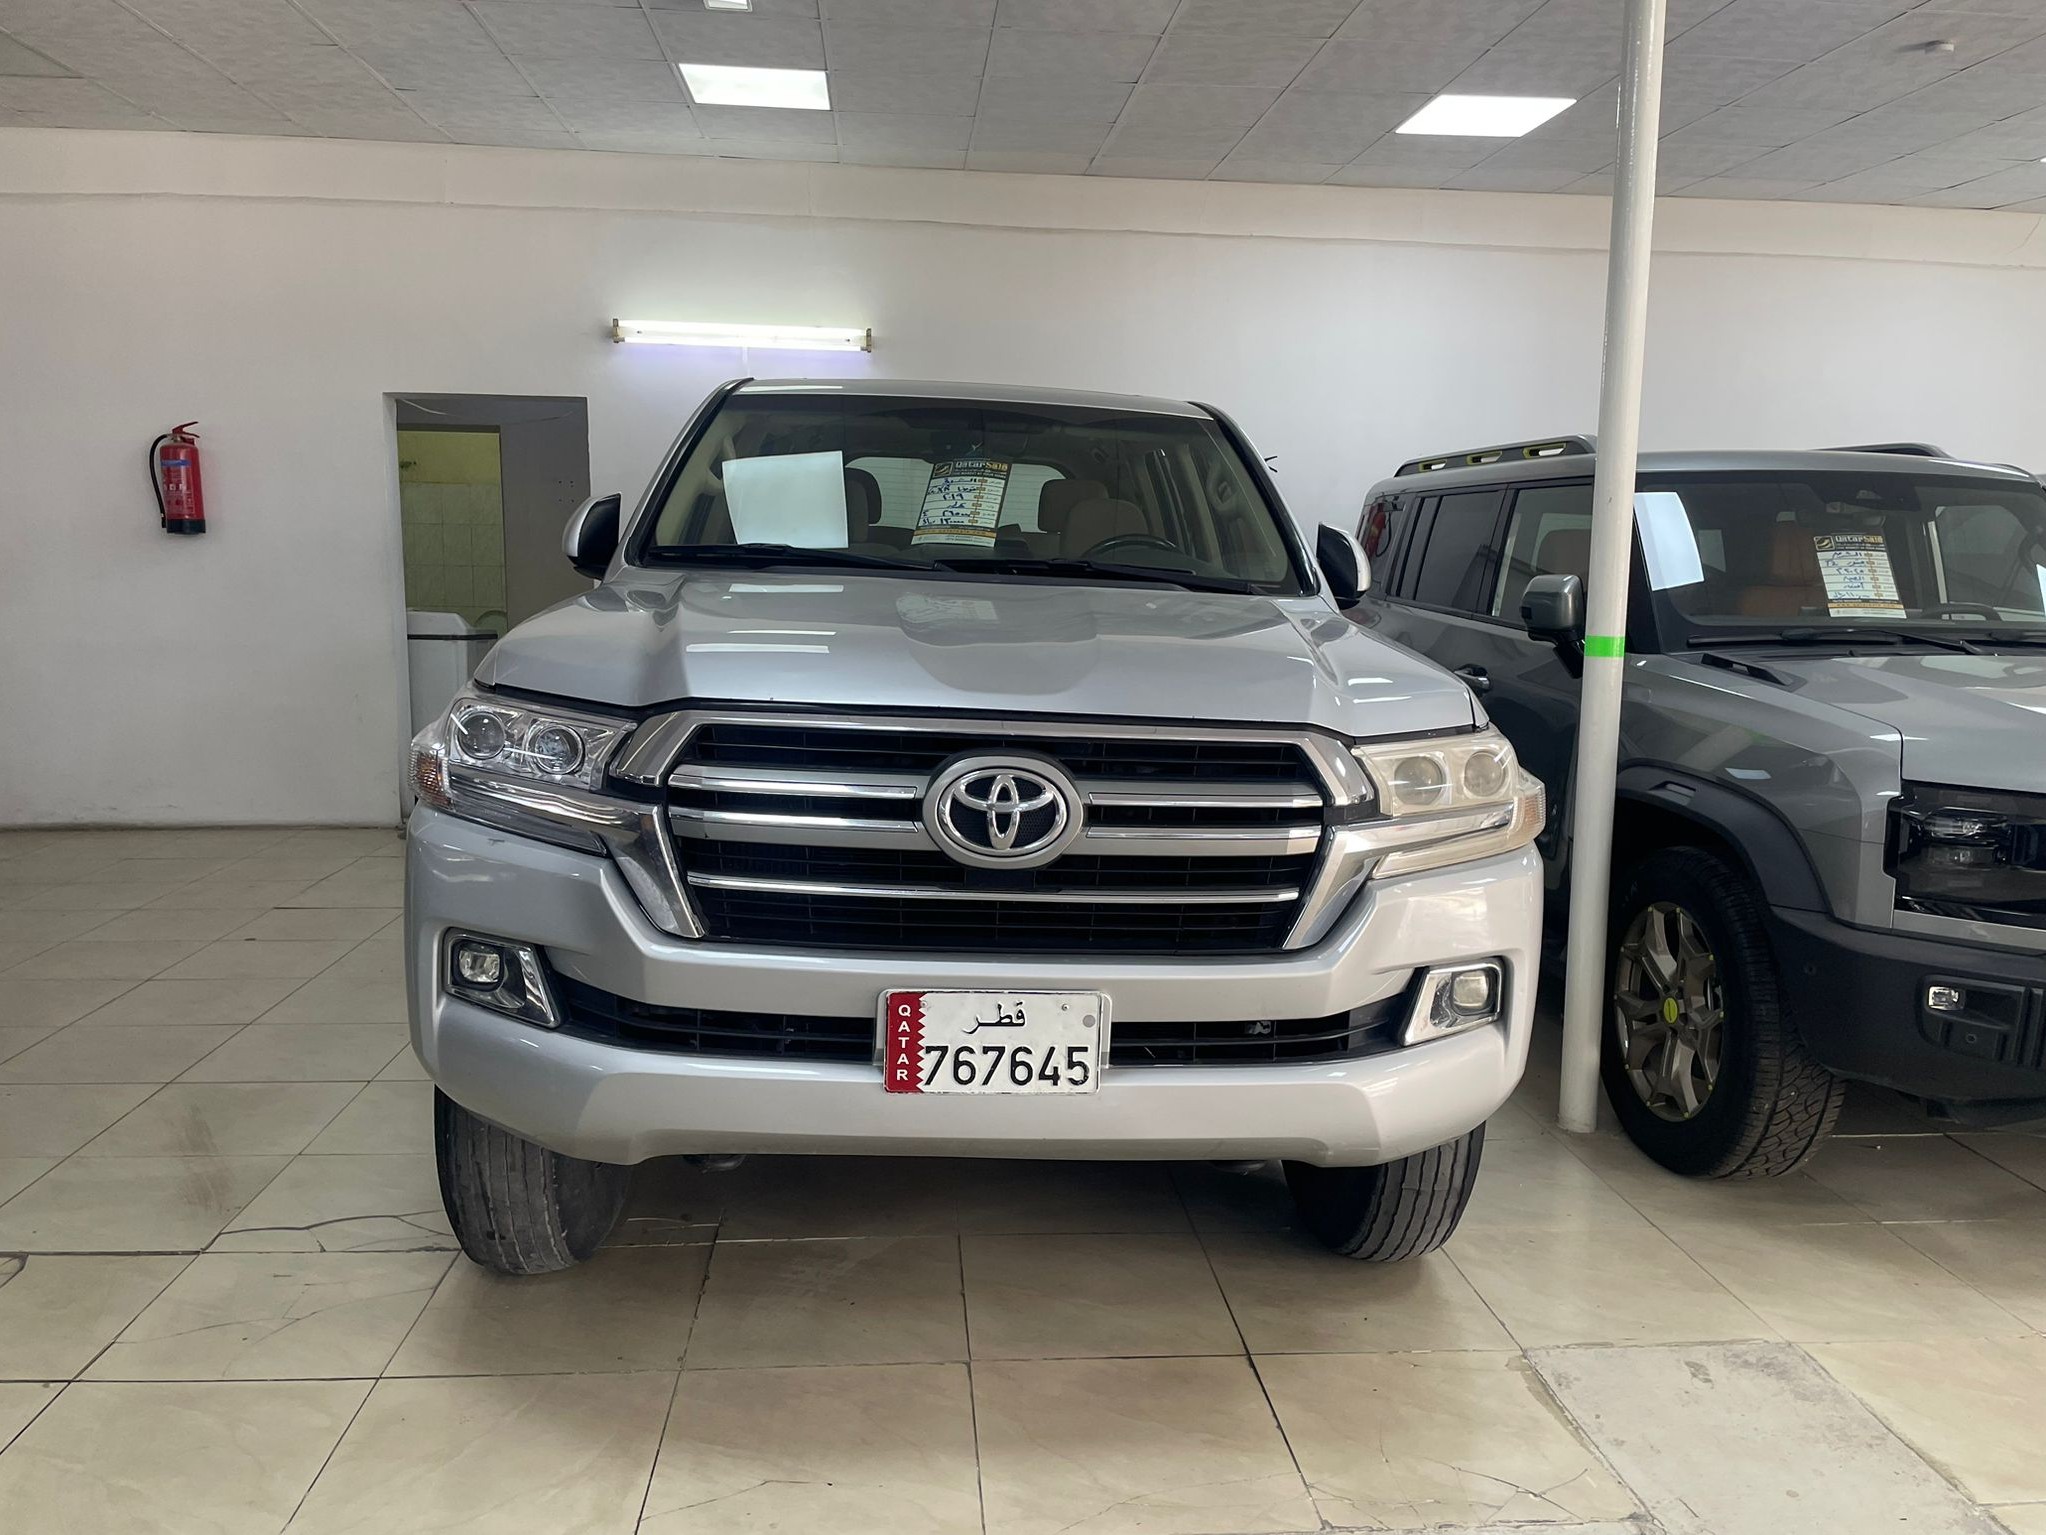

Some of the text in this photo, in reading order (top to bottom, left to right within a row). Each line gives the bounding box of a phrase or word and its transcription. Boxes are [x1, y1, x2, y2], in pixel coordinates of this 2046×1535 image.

[961, 1001, 1027, 1034] قطر
[896, 1004, 911, 1081] QATAR
[924, 1045, 1090, 1086] 767645
